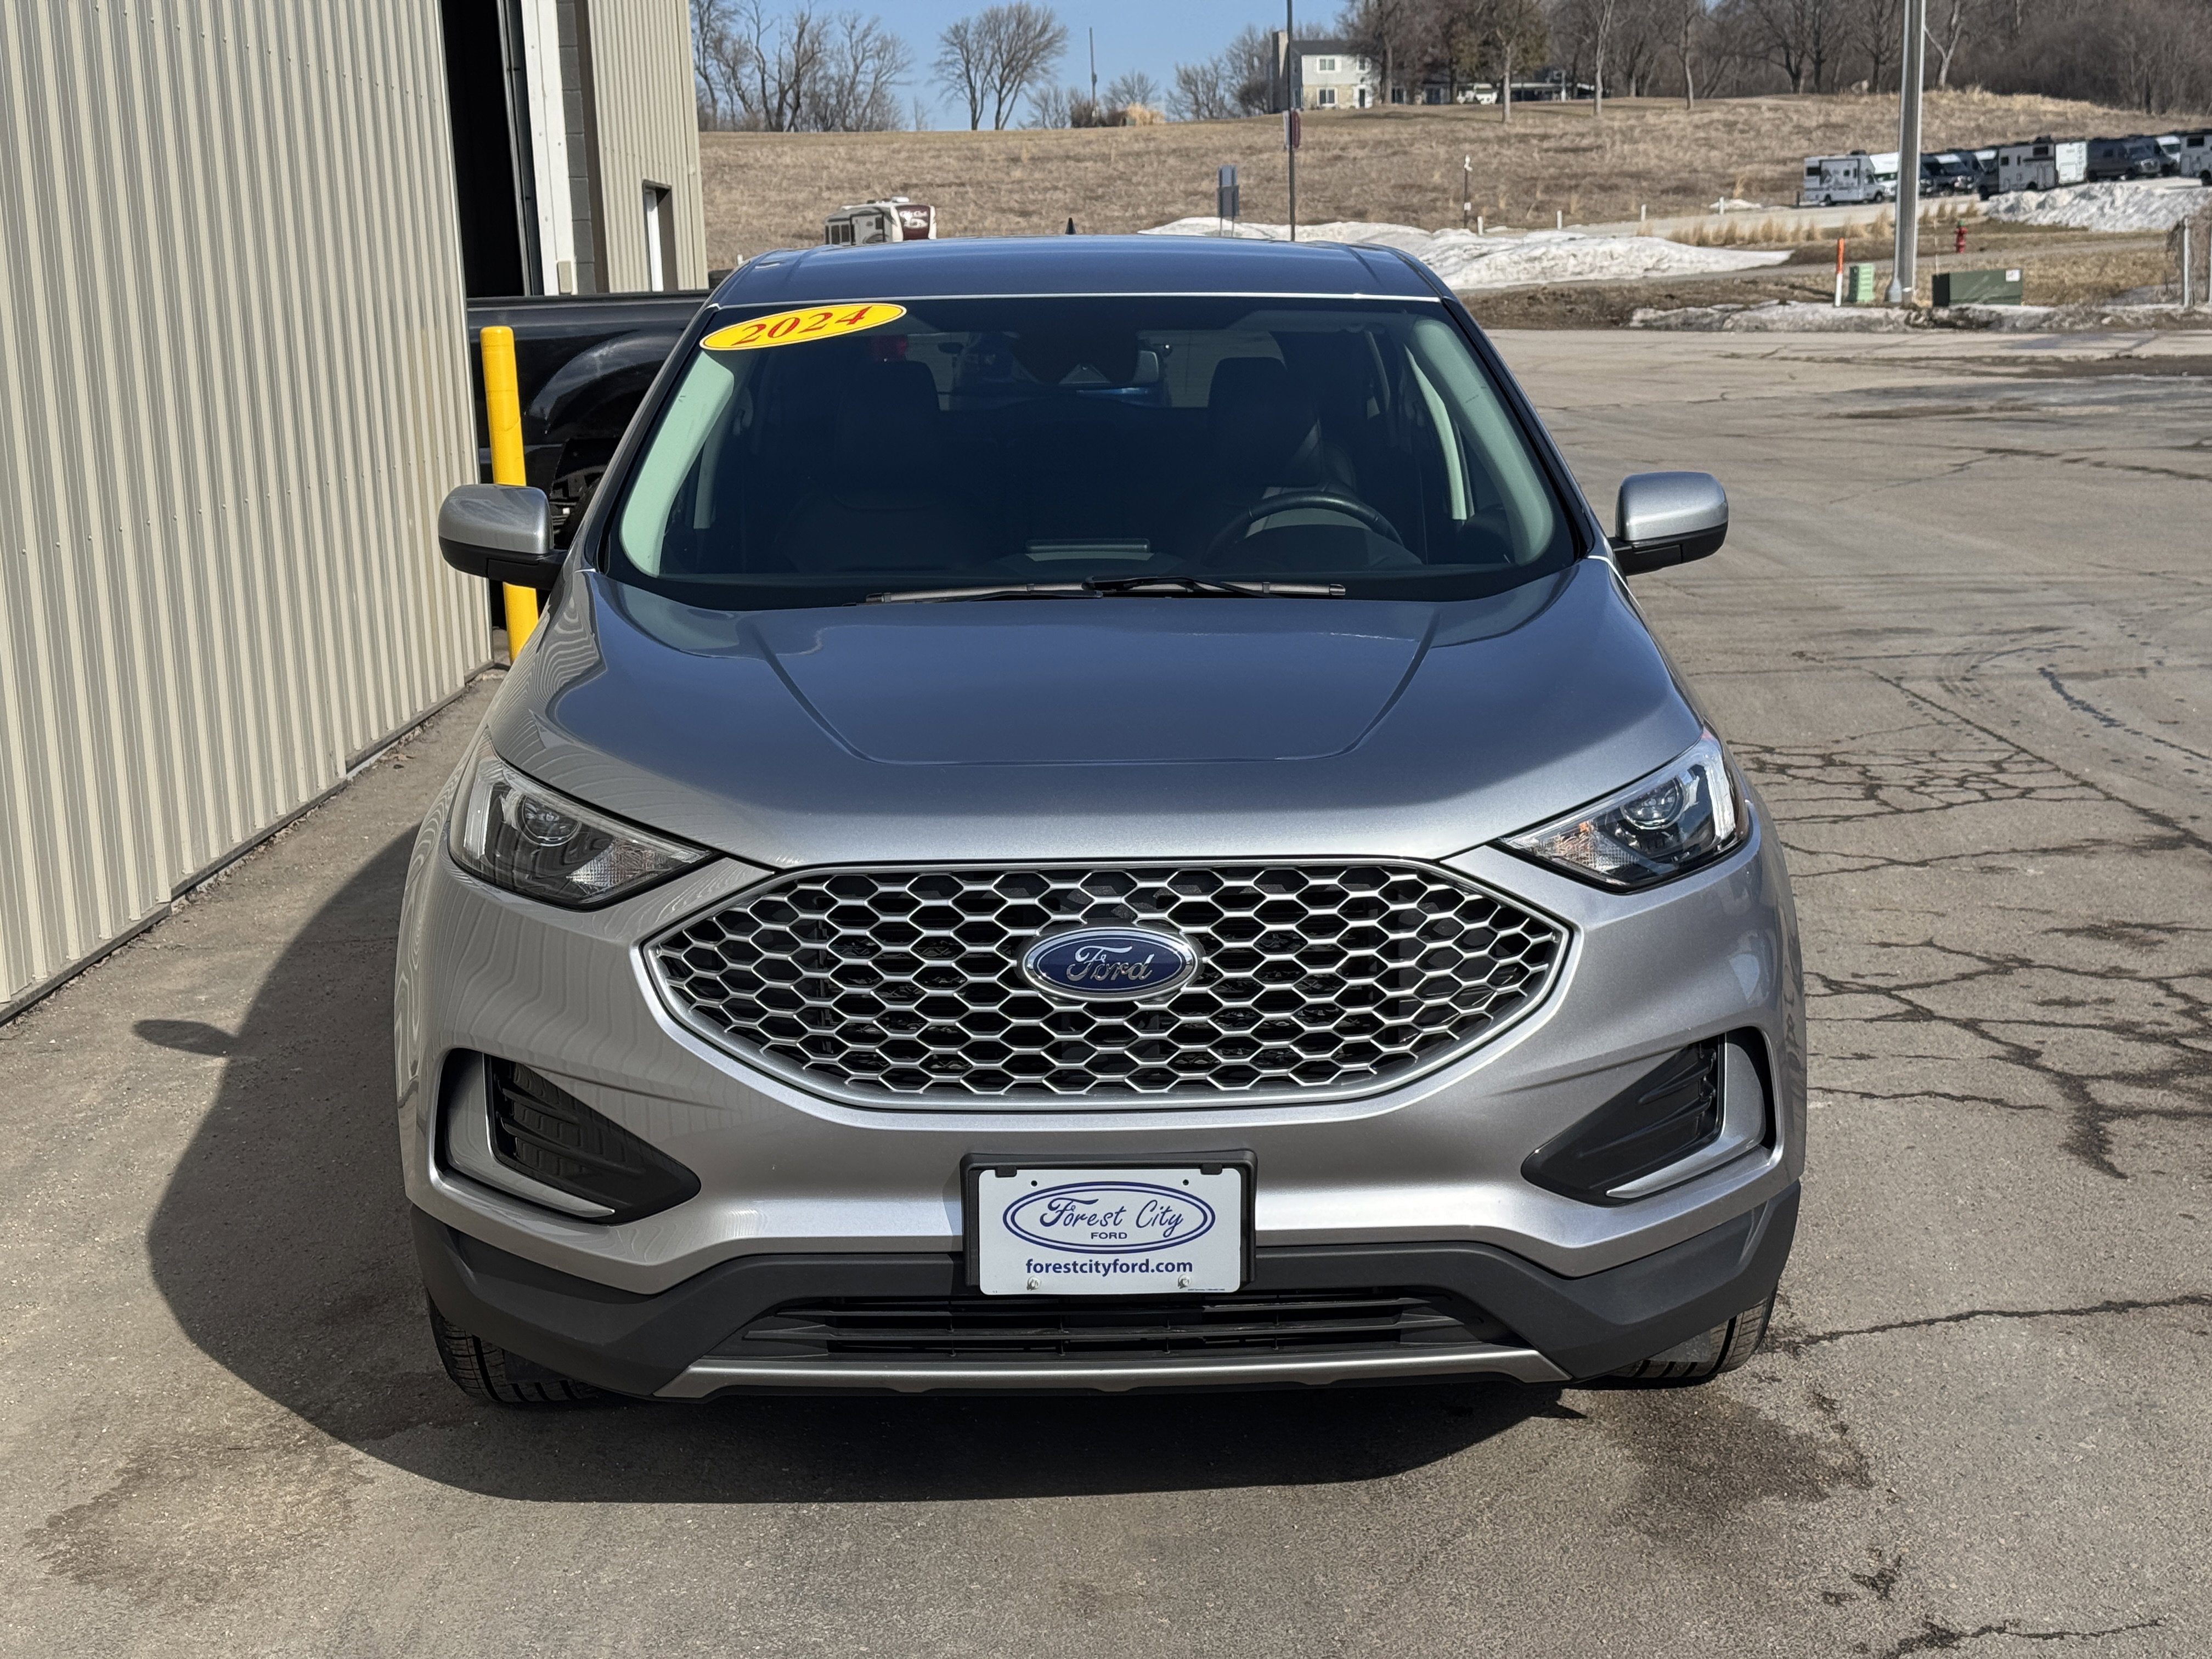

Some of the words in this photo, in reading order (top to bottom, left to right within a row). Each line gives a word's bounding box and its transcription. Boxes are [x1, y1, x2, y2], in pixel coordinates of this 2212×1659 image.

[731, 305, 872, 347] 2024
[1066, 945, 1155, 981] Ford
[1039, 1197, 1127, 1227] Forest
[1136, 1199, 1184, 1238] City
[1091, 1232, 1128, 1240] FORD
[1025, 1259, 1193, 1277] forestcityford.com
